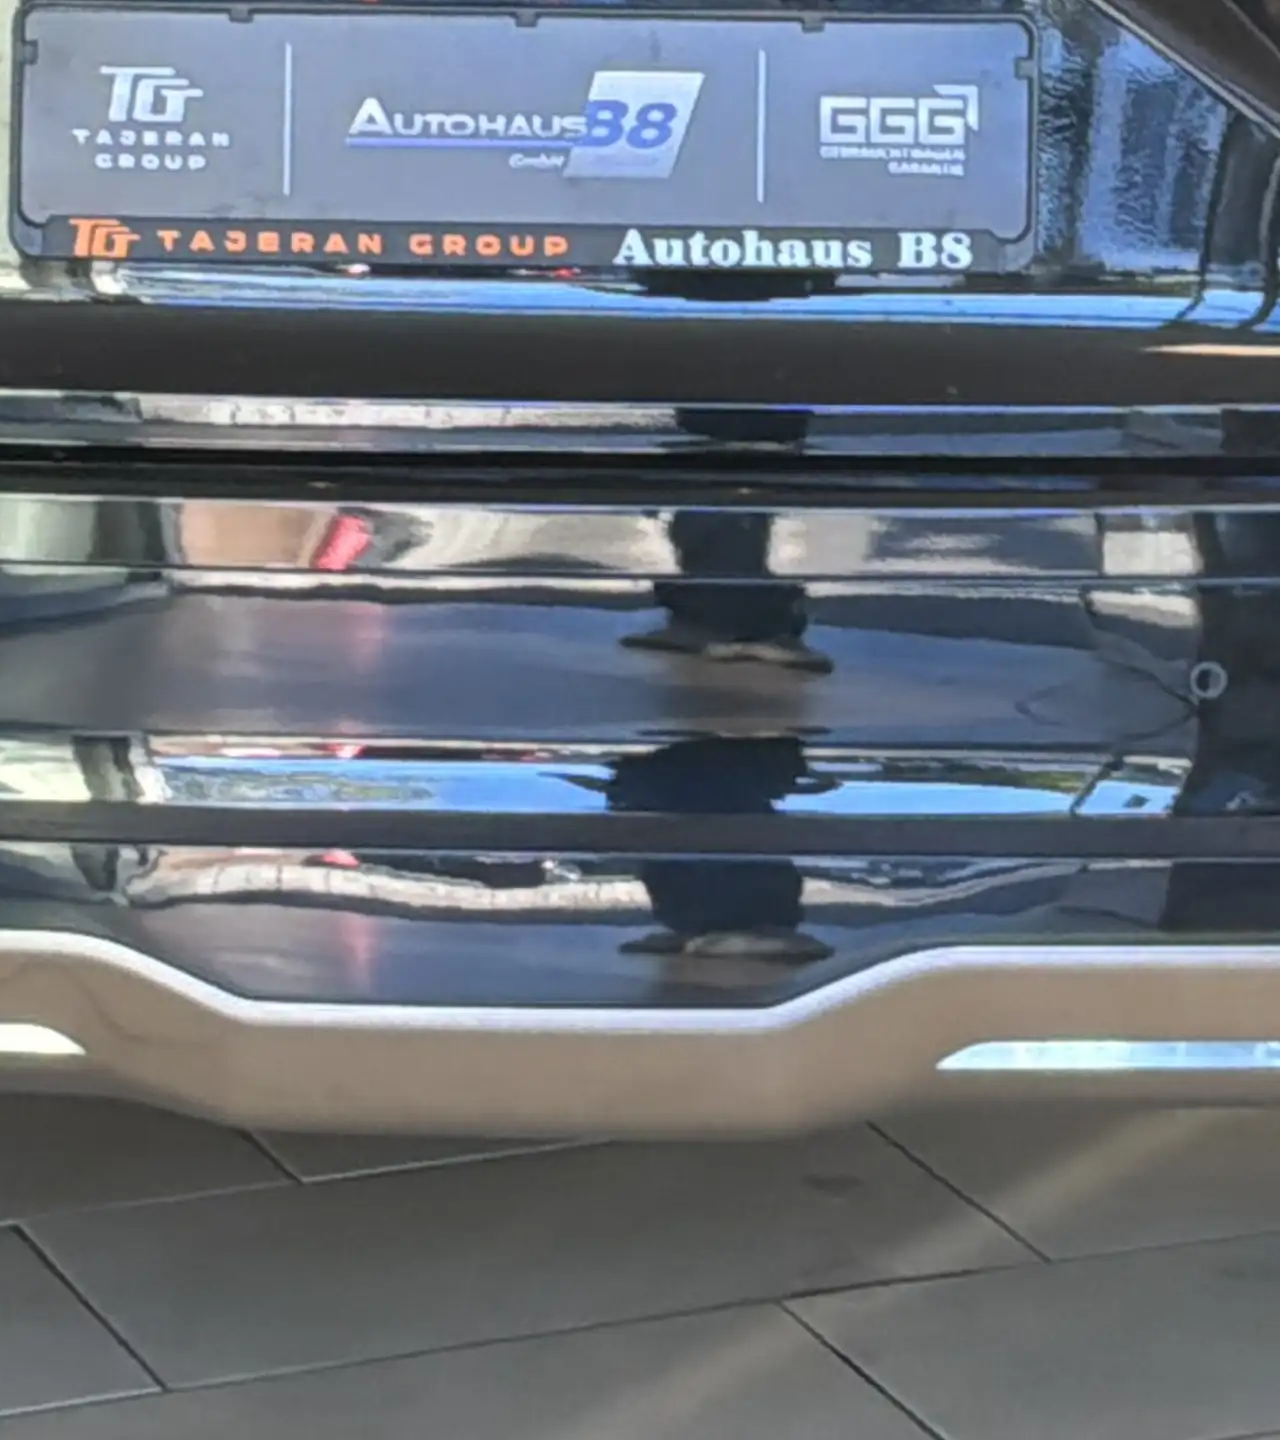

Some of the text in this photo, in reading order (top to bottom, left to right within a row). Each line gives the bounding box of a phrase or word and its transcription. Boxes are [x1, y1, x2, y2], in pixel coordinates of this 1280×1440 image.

[99, 66, 204, 122] TG
[71, 128, 231, 147] TAJERAN
[581, 100, 678, 149] B8
[820, 96, 966, 145] GGG
[94, 153, 207, 170] GROUP
[156, 229, 383, 255] TAJERAN
[408, 233, 569, 257] GROUP
[612, 228, 873, 267] Autohaus
[897, 231, 973, 269] B8
